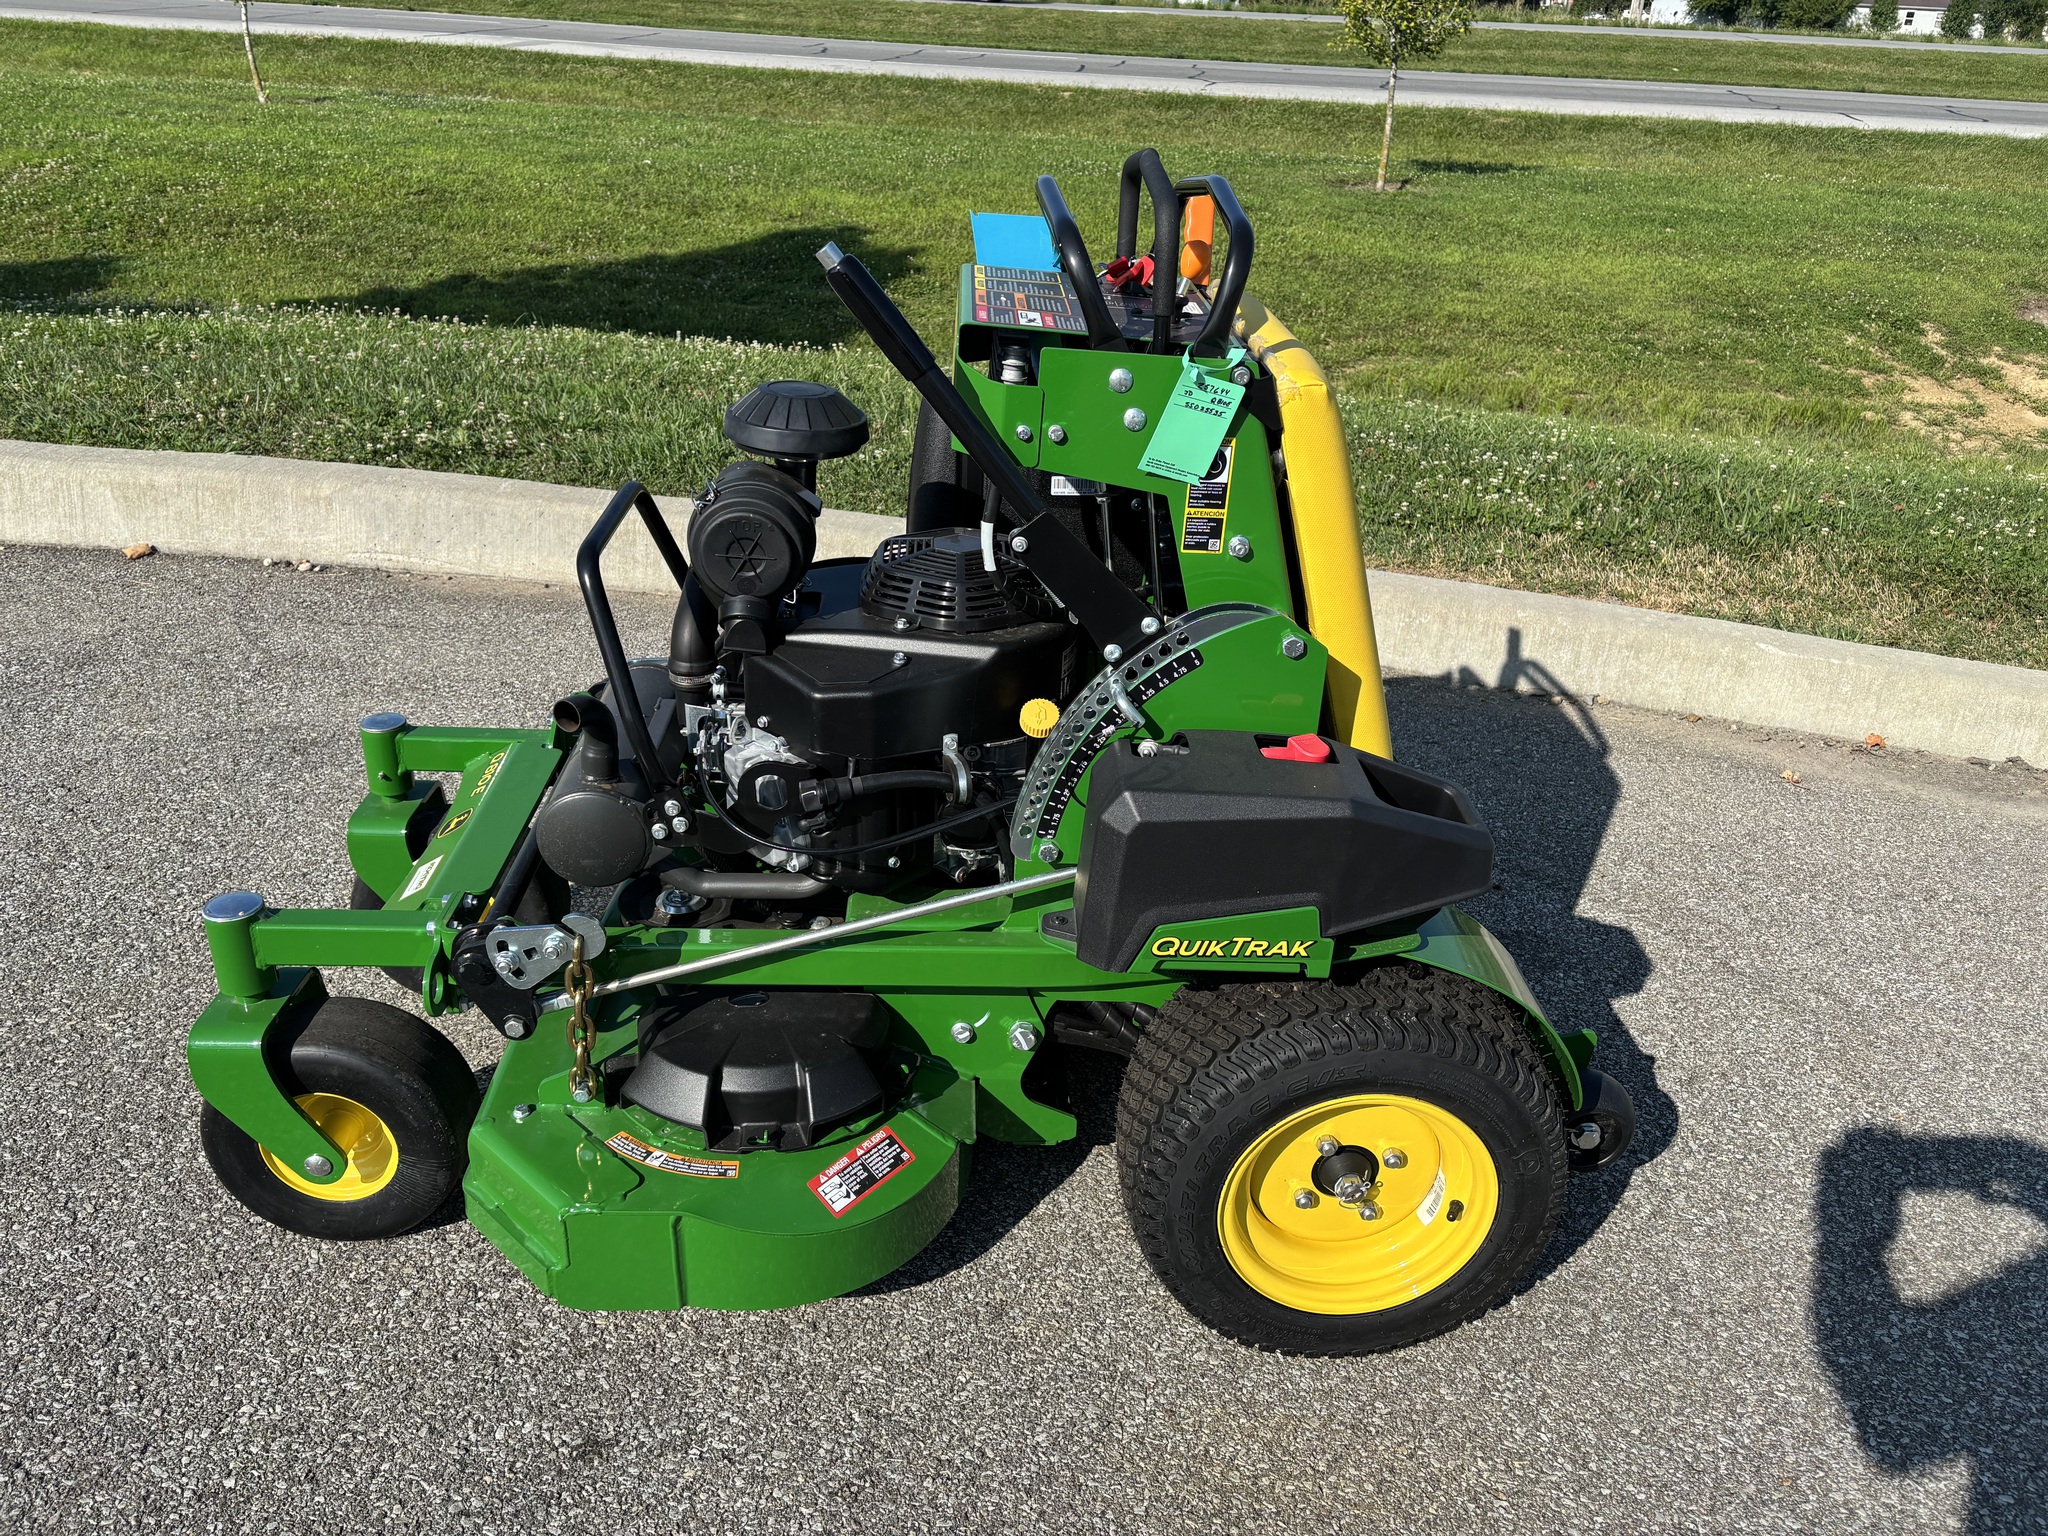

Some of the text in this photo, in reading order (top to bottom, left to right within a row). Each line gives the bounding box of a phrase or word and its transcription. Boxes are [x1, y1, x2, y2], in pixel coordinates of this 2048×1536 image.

[731, 520, 762, 533] TOP
[1052, 813, 1060, 826] 1.75
[1076, 761, 1088, 774] 2.75
[1116, 714, 1126, 724] 3.7
[1142, 688, 1156, 700] 4.25
[1158, 678, 1170, 688] 4.5
[1173, 666, 1188, 678] 4.75
[862, 1130, 886, 1150] PELIGRO
[1195, 1095, 1271, 1174] TRAC
[825, 1156, 850, 1177] DANGER
